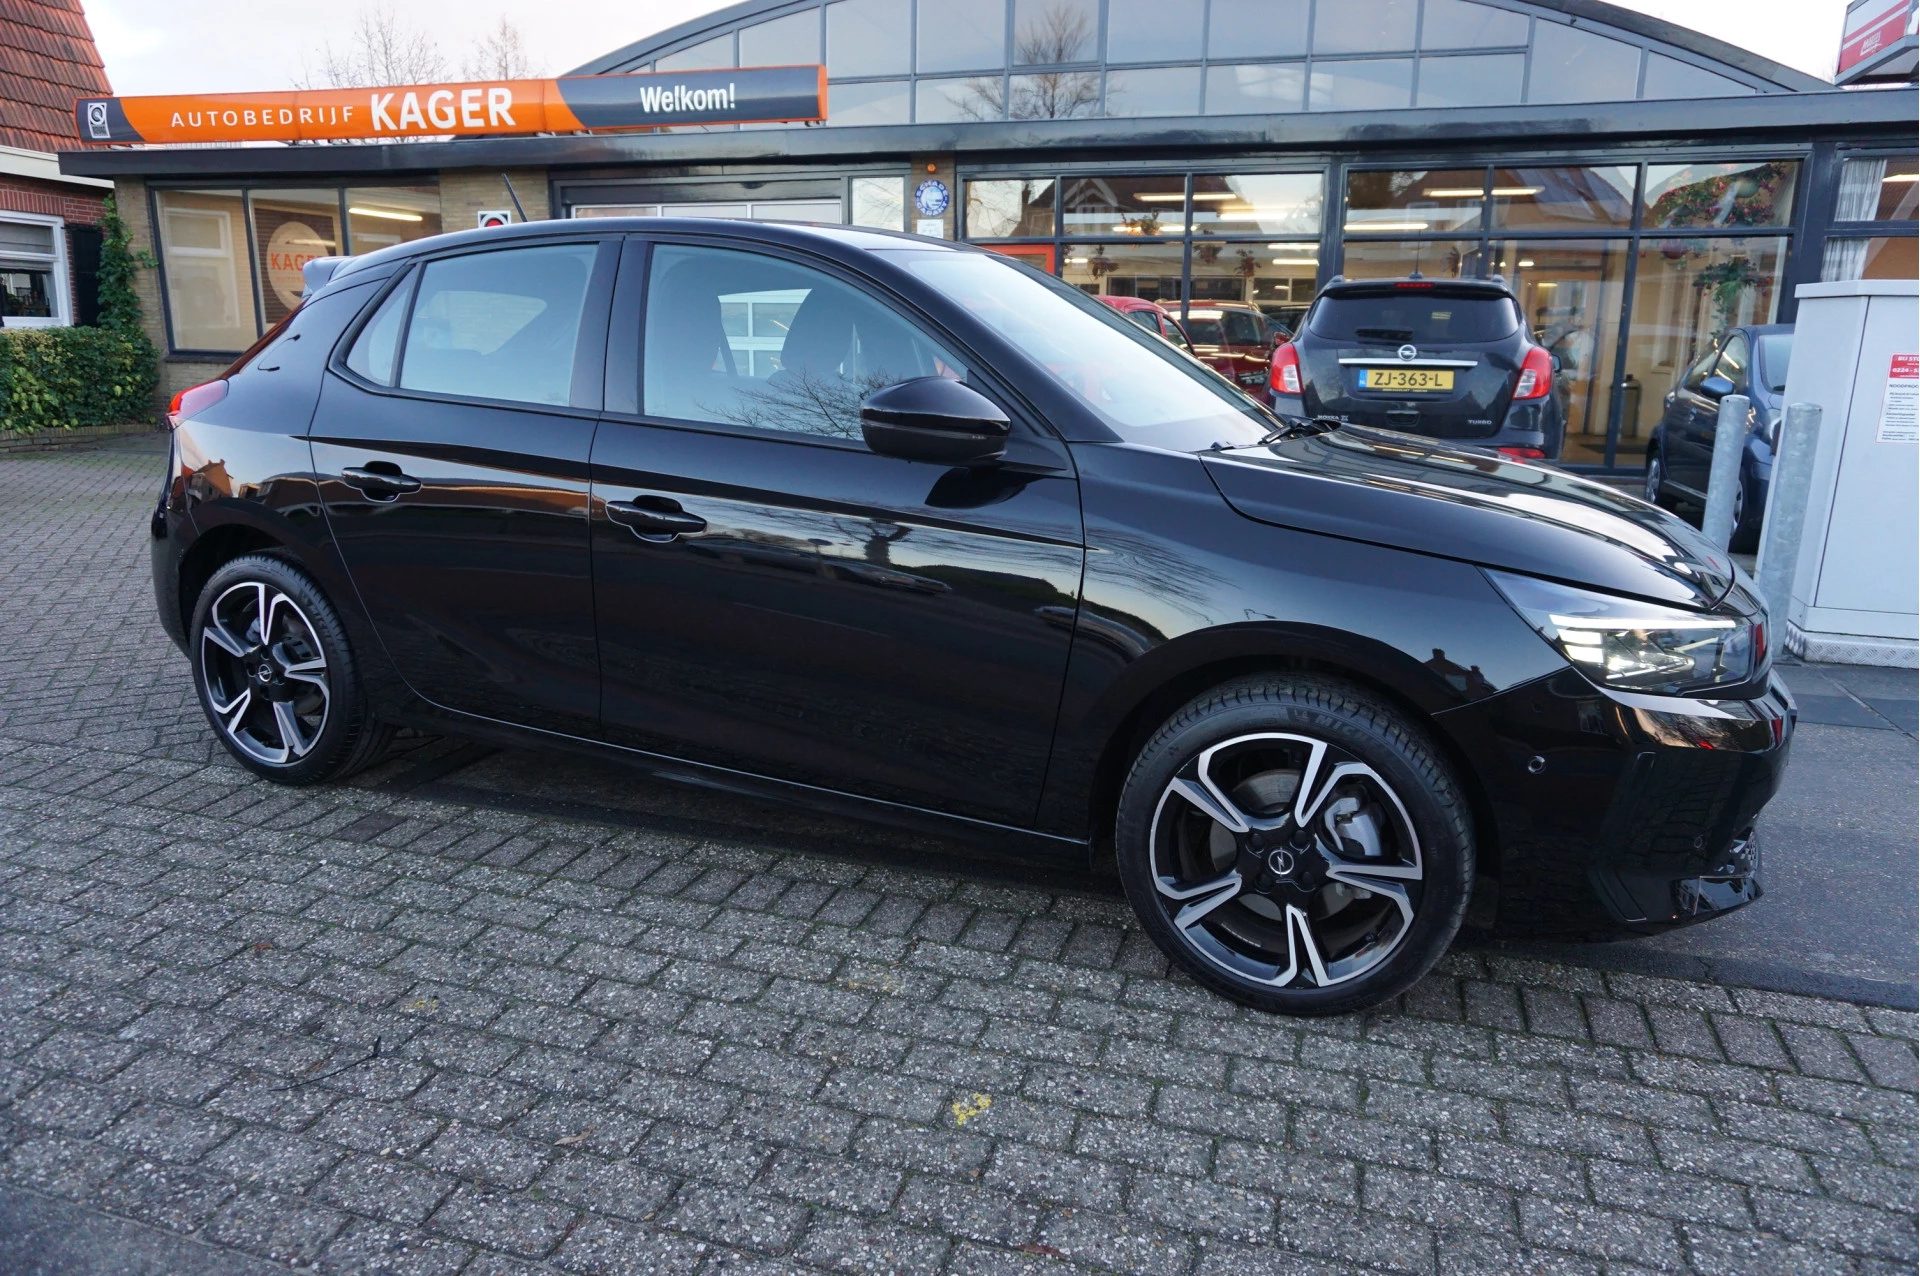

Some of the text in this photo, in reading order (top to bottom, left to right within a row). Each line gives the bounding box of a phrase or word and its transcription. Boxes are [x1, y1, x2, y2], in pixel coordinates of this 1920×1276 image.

[171, 87, 516, 131] AUTOBEDRIJF KAGER
[639, 83, 736, 113] Welkom!
[270, 252, 323, 272] KAG
[1374, 372, 1443, 386] ZJ-363-L
